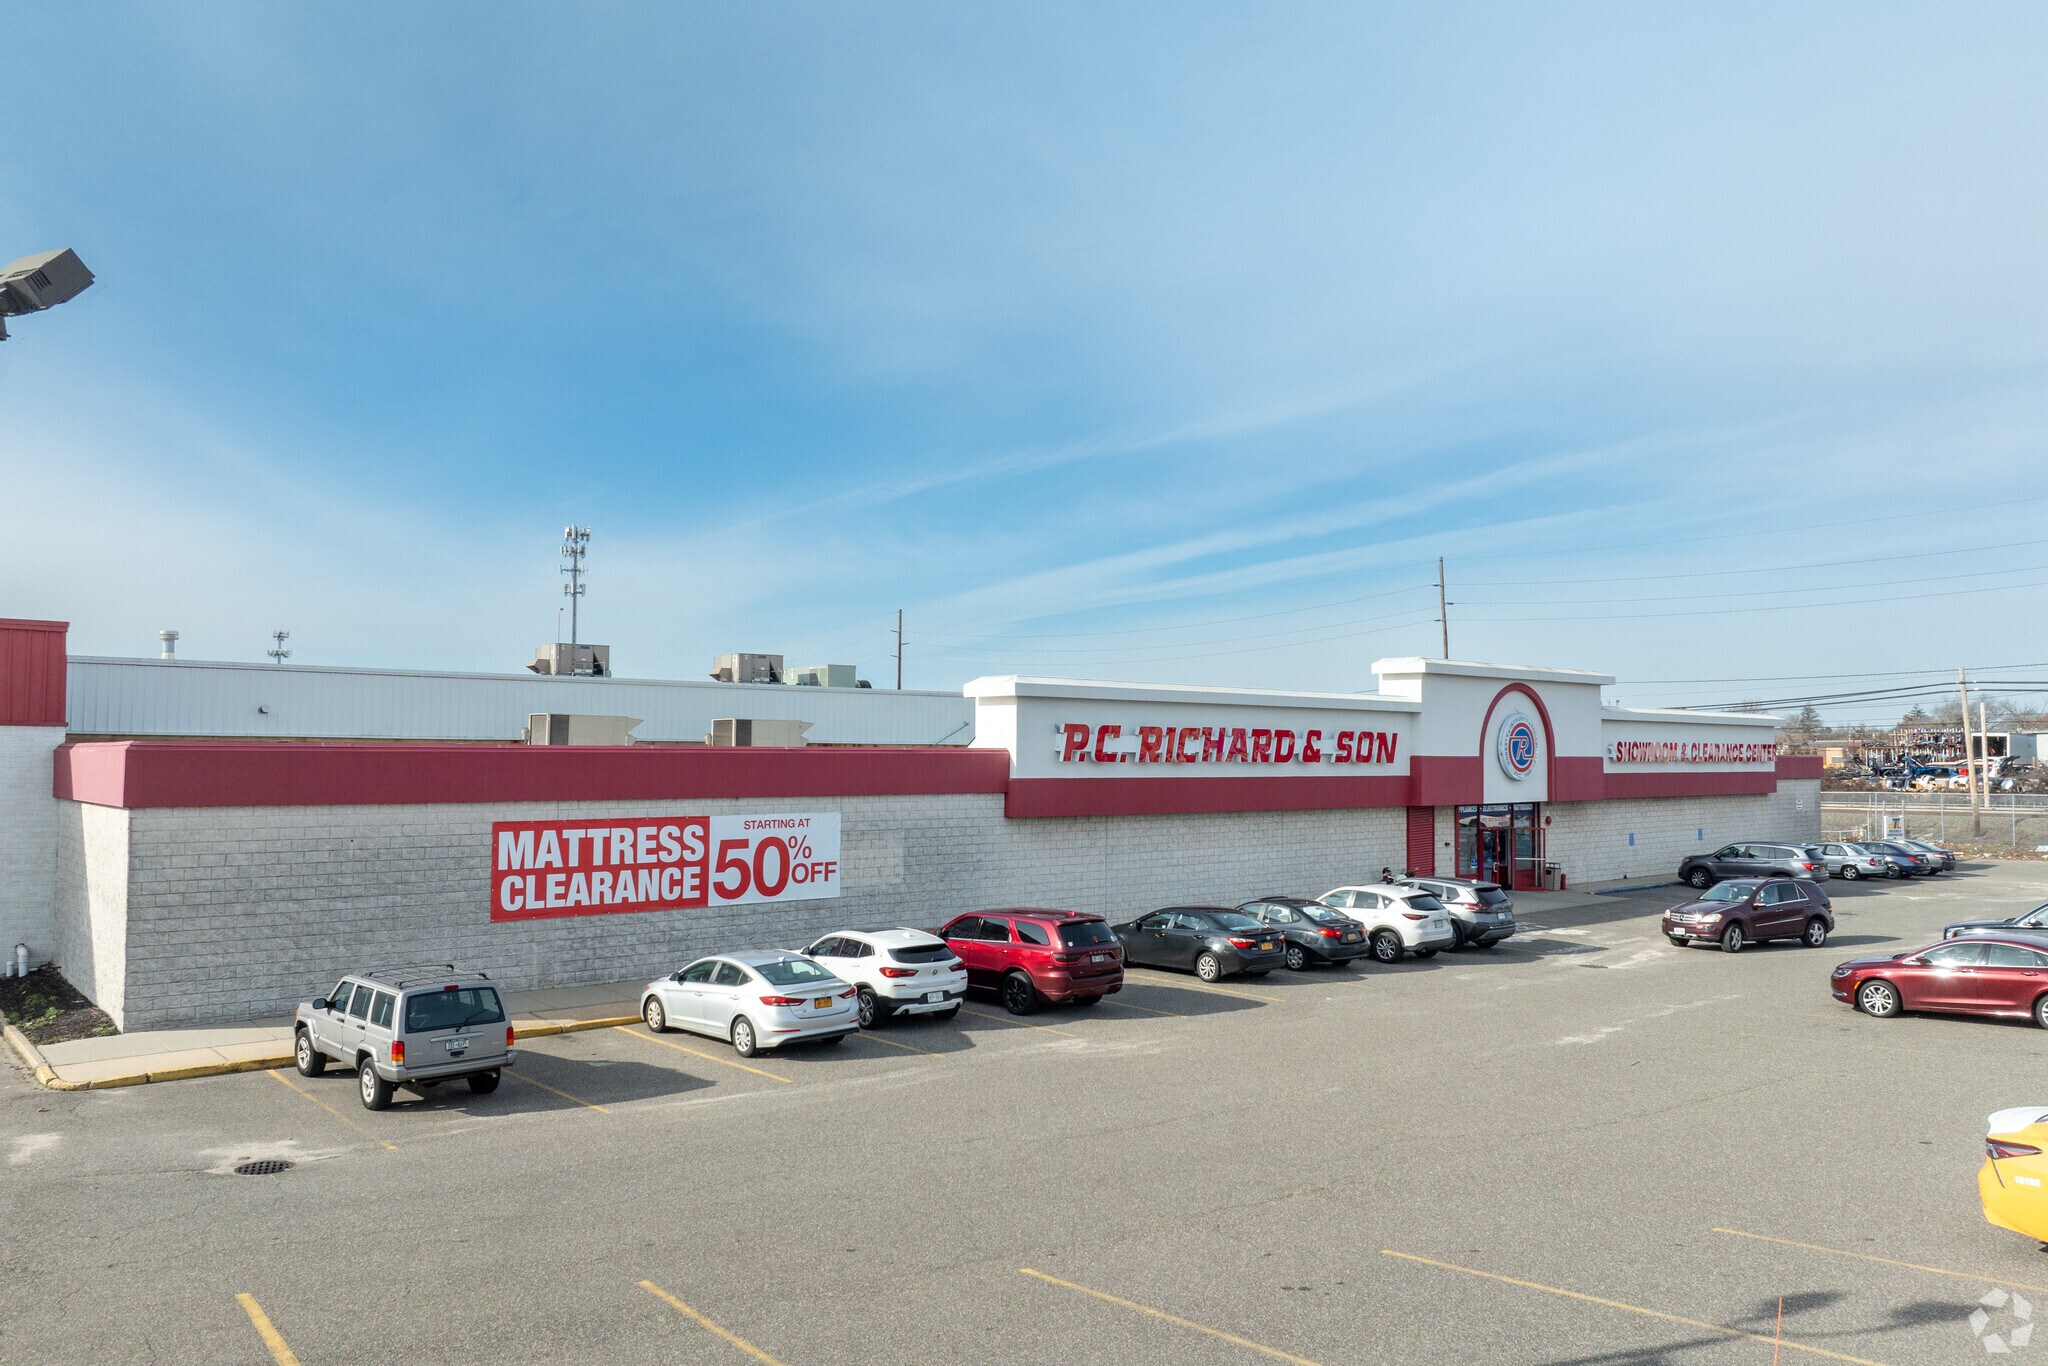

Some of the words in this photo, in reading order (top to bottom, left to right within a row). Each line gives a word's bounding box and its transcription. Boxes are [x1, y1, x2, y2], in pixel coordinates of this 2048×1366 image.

[1135, 725, 1296, 764] RICHARD
[1300, 729, 1323, 764] &
[1333, 730, 1399, 764] SON
[1615, 741, 1678, 763] SHOWROOM
[1680, 742, 1688, 763] &
[1690, 743, 1744, 763] CLEARANCE
[1745, 743, 1776, 763] CENTER
[743, 819, 796, 830] STARTING
[797, 818, 811, 828] AT
[498, 824, 705, 870] MATTRESS
[791, 861, 838, 885] OFF
[500, 867, 701, 911] CLEARANCE
